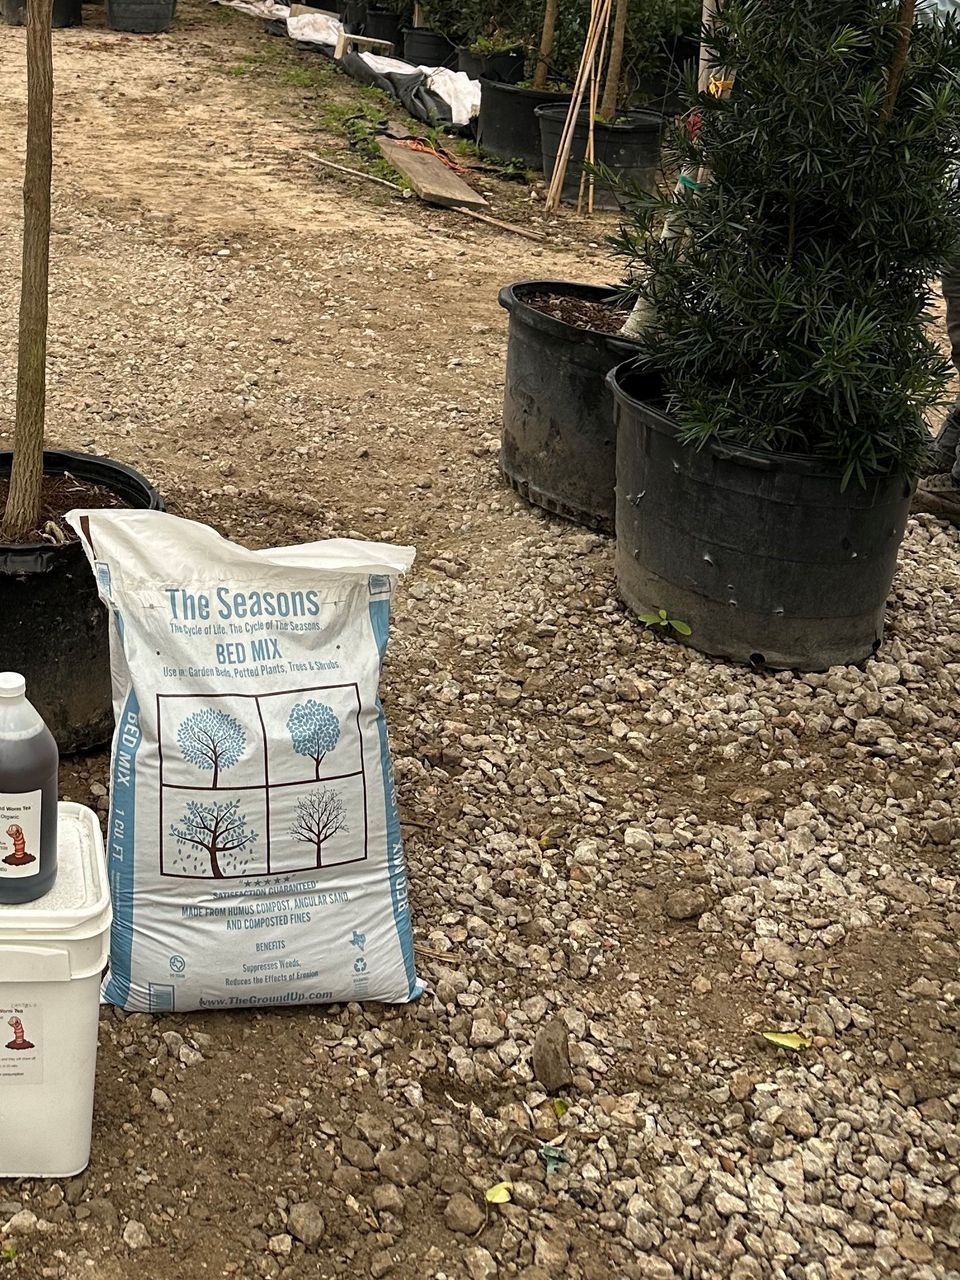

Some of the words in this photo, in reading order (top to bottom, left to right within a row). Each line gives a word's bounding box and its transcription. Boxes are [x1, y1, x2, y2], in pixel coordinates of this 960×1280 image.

[165, 588, 210, 620] The
[216, 587, 320, 620] Seasons
[170, 623, 183, 634] The
[183, 624, 202, 637] Cycle
[204, 623, 212, 635] of
[229, 623, 243, 634] The
[245, 621, 264, 635] Cycle
[265, 620, 274, 631] of
[276, 620, 289, 631] The
[216, 642, 246, 665] BED
[251, 638, 283, 662] MIX
[163, 667, 177, 677] Use
[188, 666, 215, 677] Garden
[234, 666, 259, 678] Potted
[260, 663, 288, 676] Plants,
[288, 661, 308, 672] Trees
[308, 662, 314, 671] &
[122, 712, 139, 749] BED
[117, 752, 132, 788] MIX
[0, 813, 20, 821] Organic
[115, 809, 125, 817] 1
[213, 889, 267, 900] SATISFACTION
[181, 906, 203, 918] MADE
[205, 906, 226, 917] FROM
[227, 905, 255, 916] HUMUS
[256, 901, 293, 915] COMPOST,
[294, 895, 327, 909] ANGULAR
[226, 919, 242, 931] AND
[244, 914, 288, 930] COMPOSTED
[290, 912, 311, 924] FINES
[255, 940, 286, 952] BENEFITS
[242, 962, 278, 974] Suppresses
[225, 975, 251, 987] Reduces
[253, 974, 264, 984] the
[264, 972, 287, 984] Effects
[289, 971, 296, 982] of
[199, 991, 333, 1008] www.TheGroundUp.com
